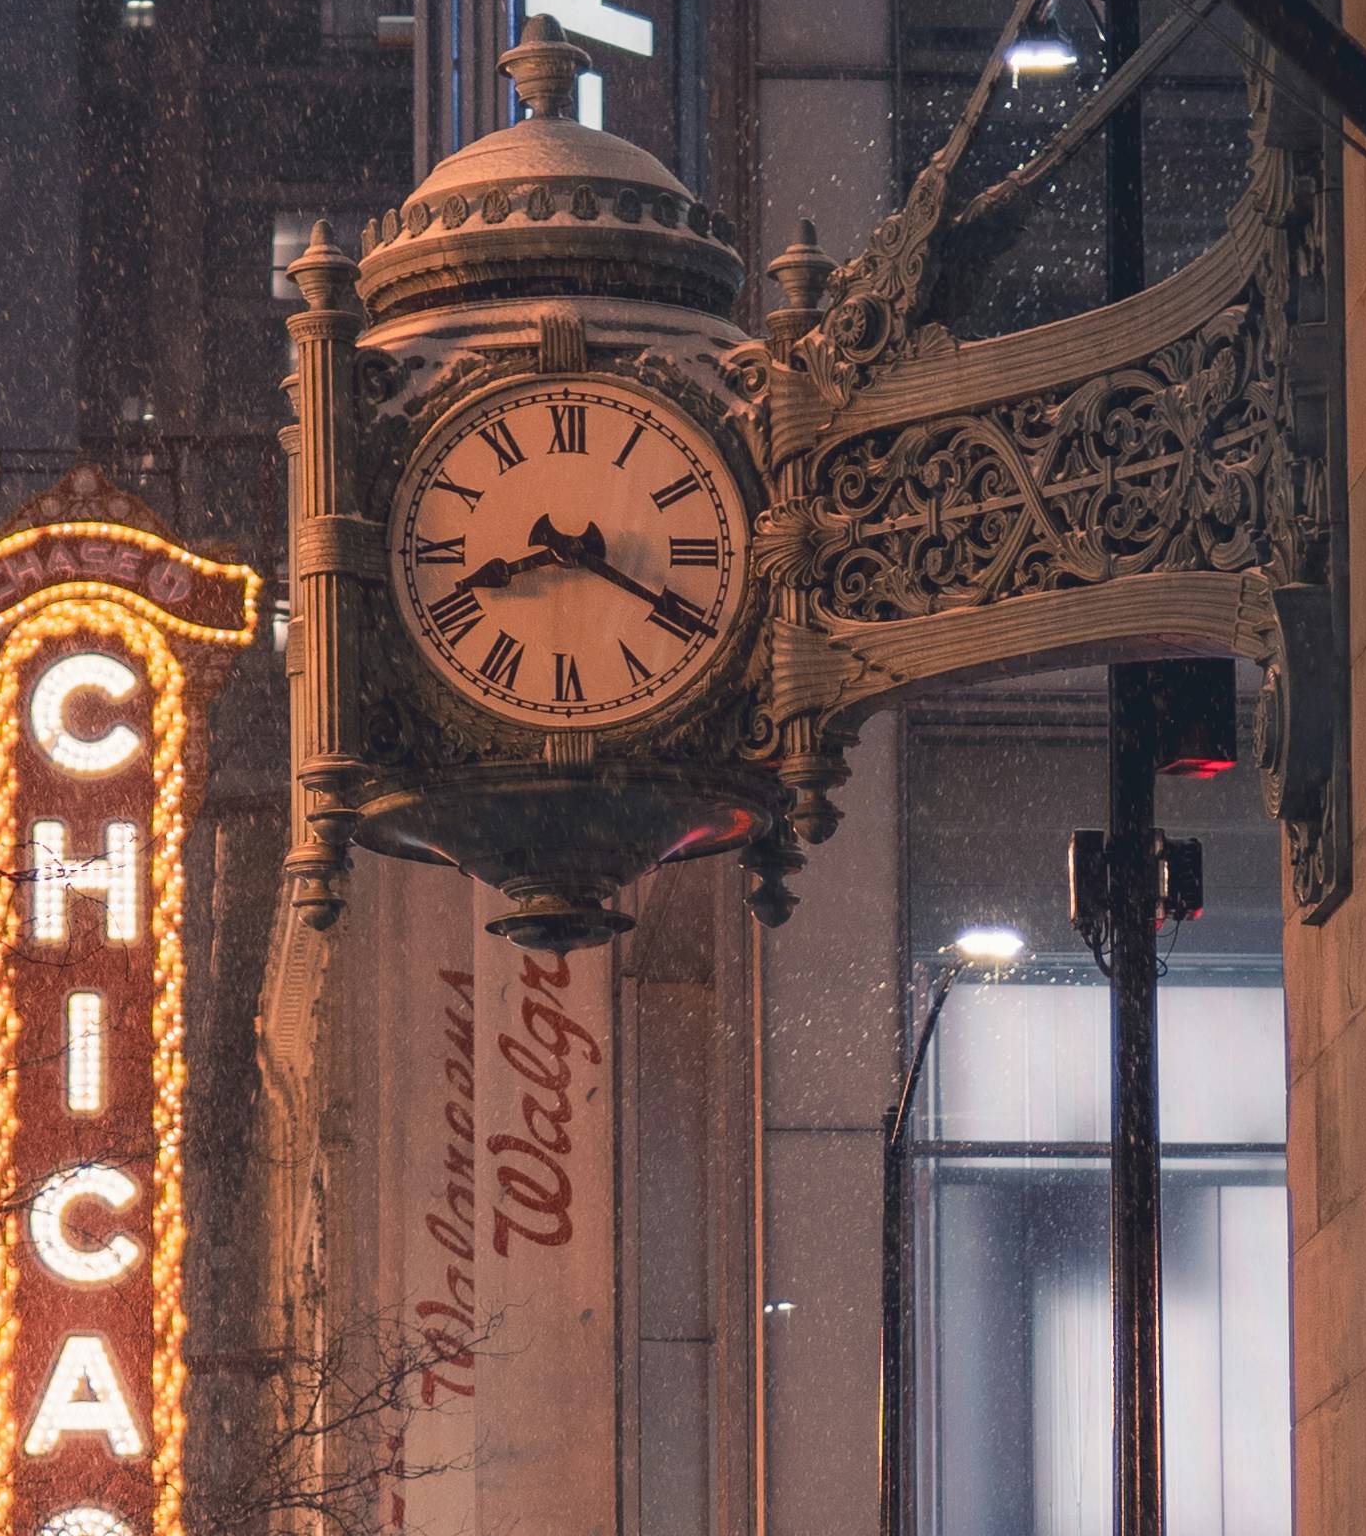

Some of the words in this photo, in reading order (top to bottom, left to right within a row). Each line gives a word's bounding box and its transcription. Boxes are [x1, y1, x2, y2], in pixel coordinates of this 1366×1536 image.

[477, 418, 528, 475] XI
[546, 405, 589, 455] XII
[431, 468, 485, 513] X
[650, 471, 702, 513] II
[416, 535, 466, 567] IX
[669, 536, 719, 569] III
[477, 629, 525, 691] VII
[551, 653, 588, 702] VI
[618, 638, 656, 688] V
[486, 953, 602, 1258] Walgr
